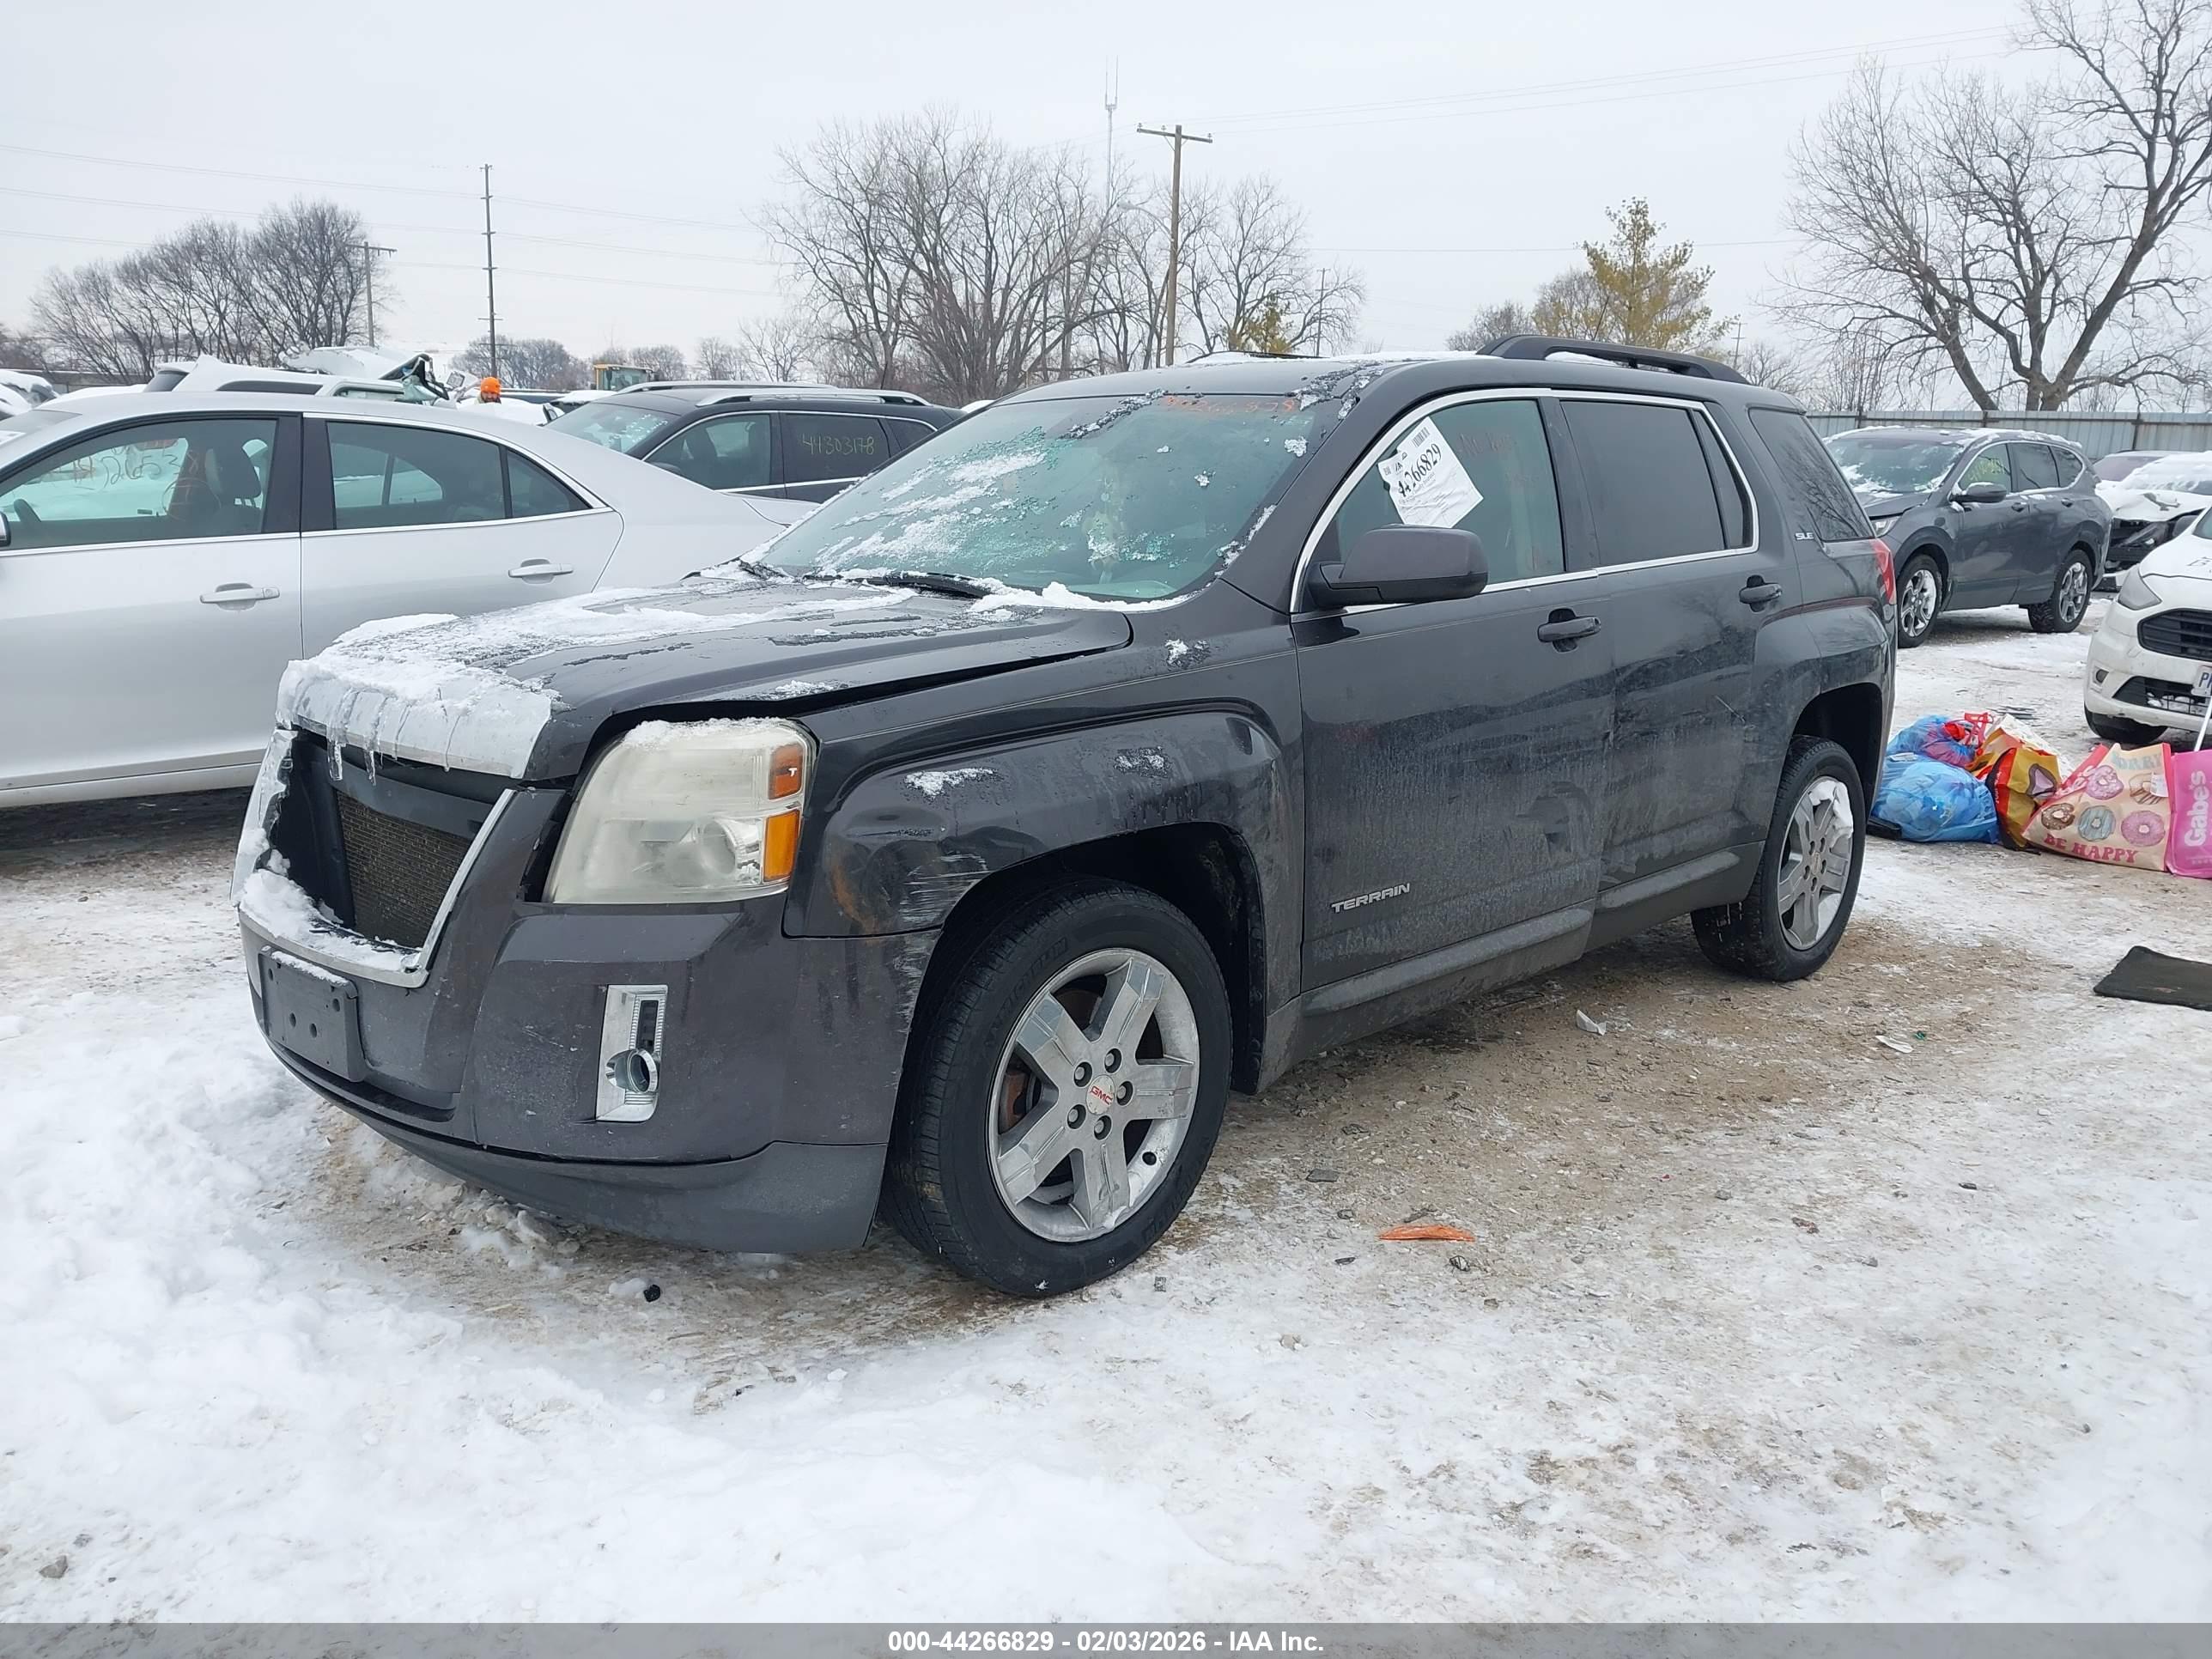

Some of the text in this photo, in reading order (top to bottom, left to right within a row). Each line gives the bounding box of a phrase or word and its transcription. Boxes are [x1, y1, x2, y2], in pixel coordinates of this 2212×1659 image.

[1795, 532, 1814, 541] SLE
[2184, 770, 2210, 847] Gabe's
[2045, 833, 2139, 863] BE HAPPY
[1331, 883, 1411, 914] TERRAIN
[1090, 1085, 1114, 1106] GMC
